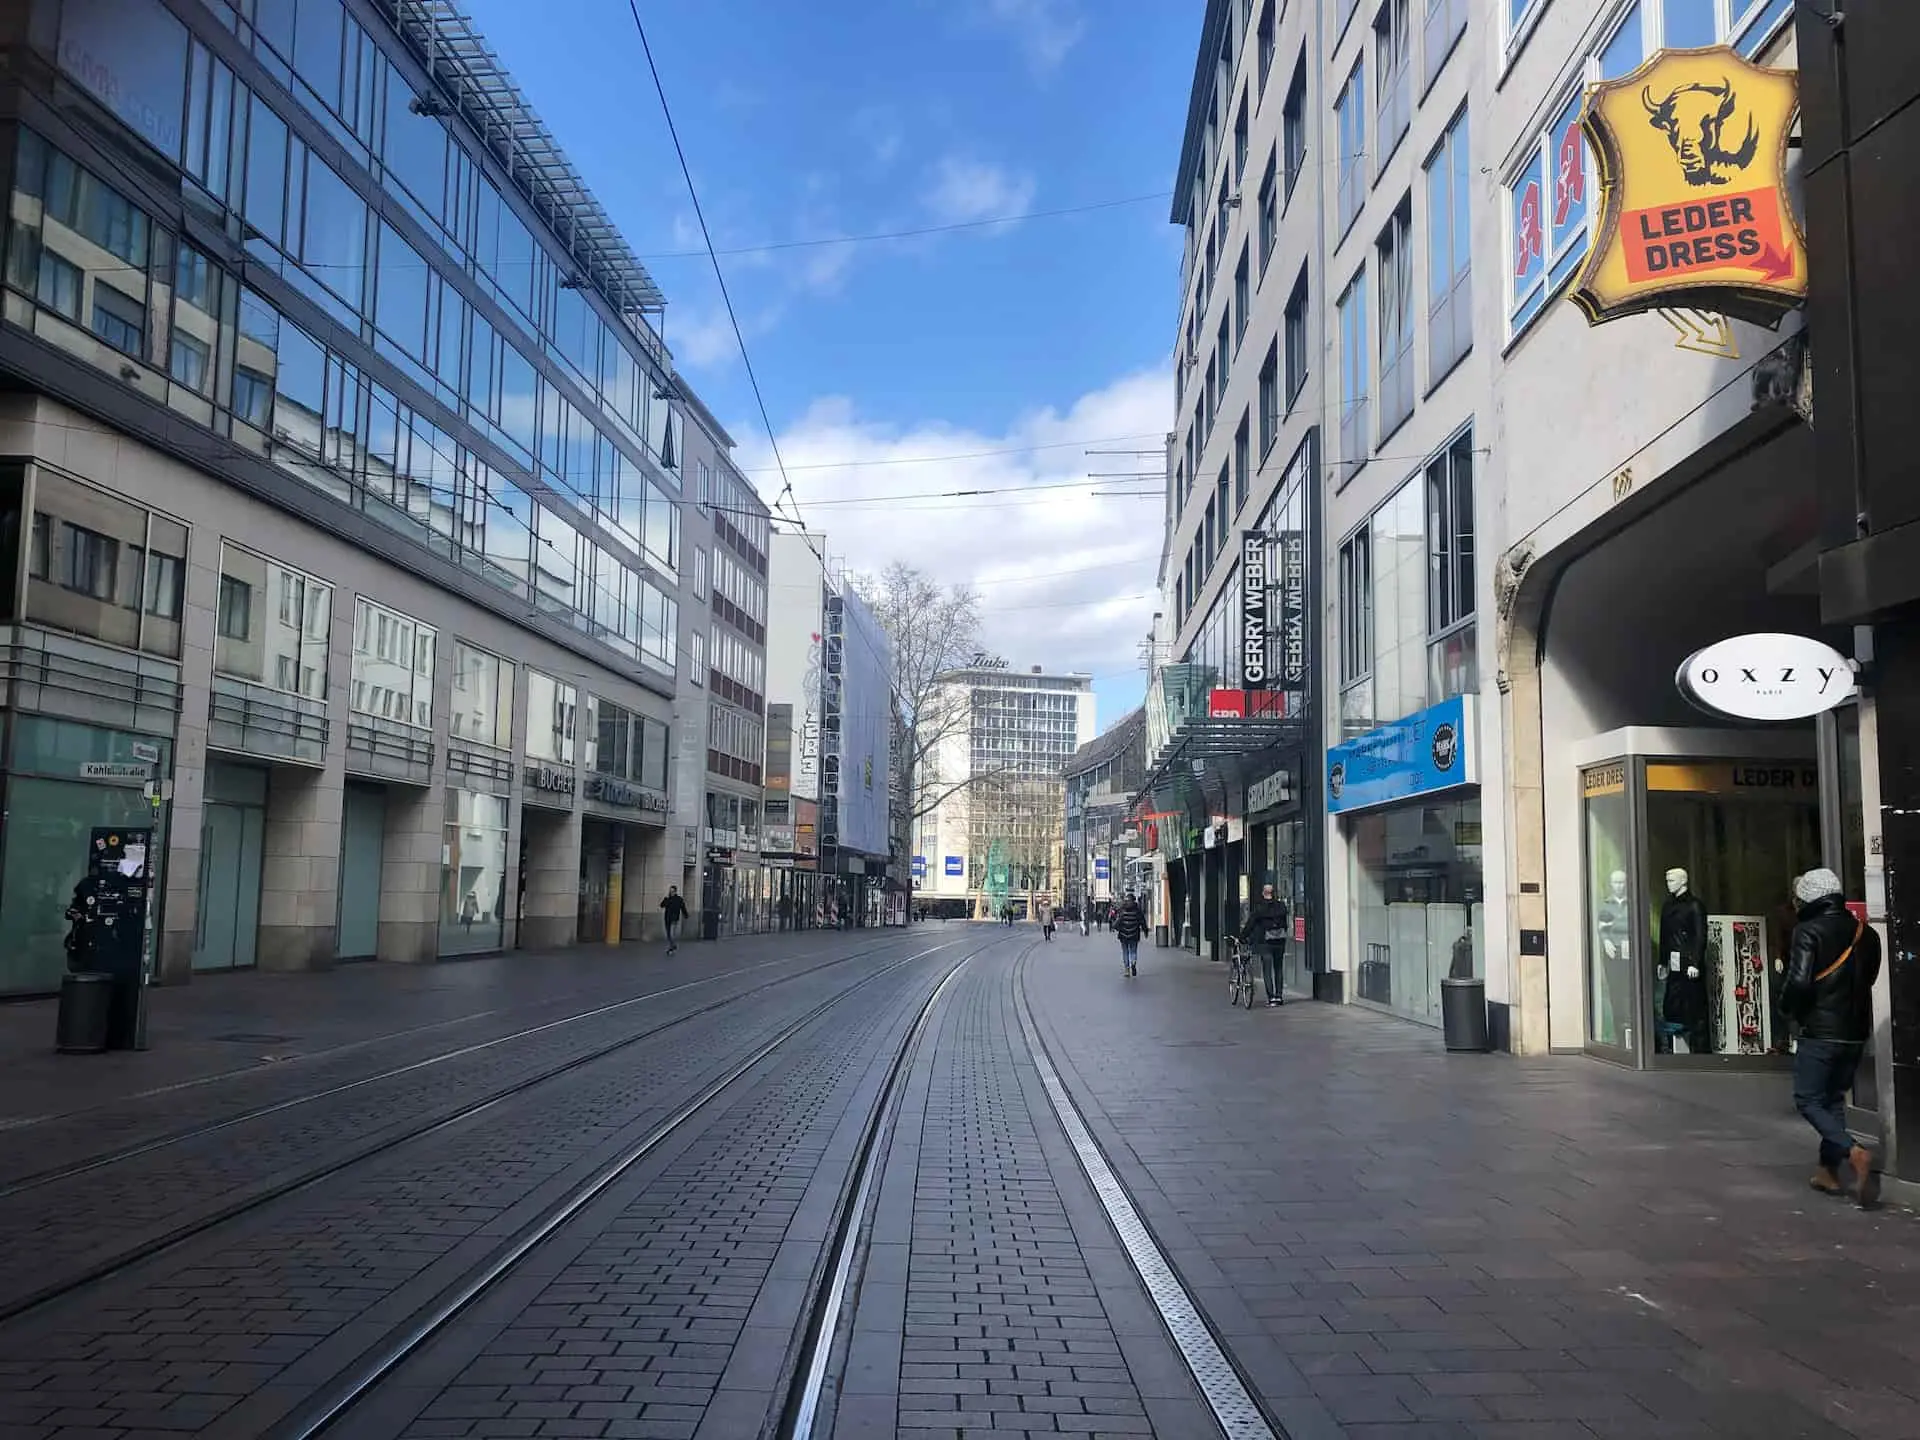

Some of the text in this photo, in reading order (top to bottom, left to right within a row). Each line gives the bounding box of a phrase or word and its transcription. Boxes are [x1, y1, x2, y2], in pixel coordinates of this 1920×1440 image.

[1640, 198, 1755, 240] LEDER
[1645, 229, 1760, 272] DRESS
[1245, 538, 1264, 682] GERRY WEBER
[1702, 667, 1834, 694] oxzy
[1733, 768, 1796, 787] LEDER
